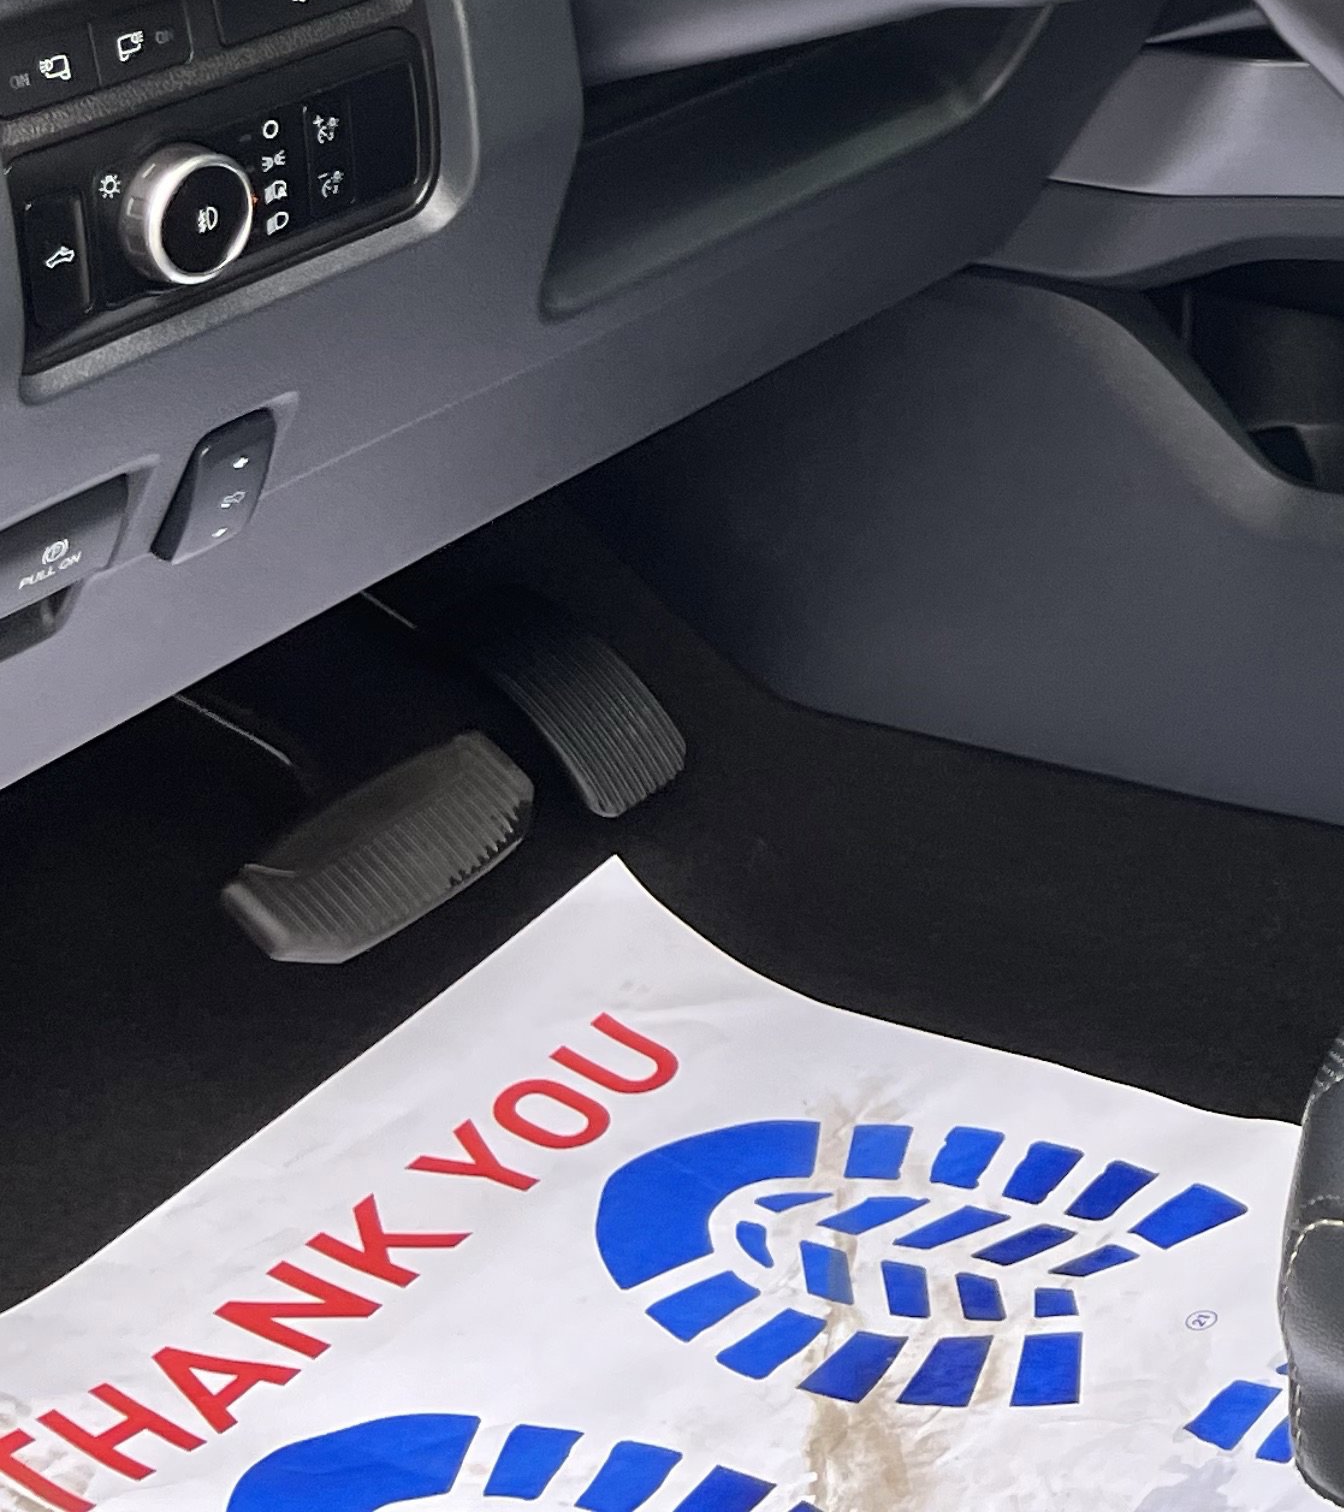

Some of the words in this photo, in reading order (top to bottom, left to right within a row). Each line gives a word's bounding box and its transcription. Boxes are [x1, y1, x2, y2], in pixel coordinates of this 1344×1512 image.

[18, 565, 56, 590] PULL
[58, 550, 82, 570] ON
[0, 1193, 472, 1512] THANK
[405, 1012, 679, 1192] YOU
